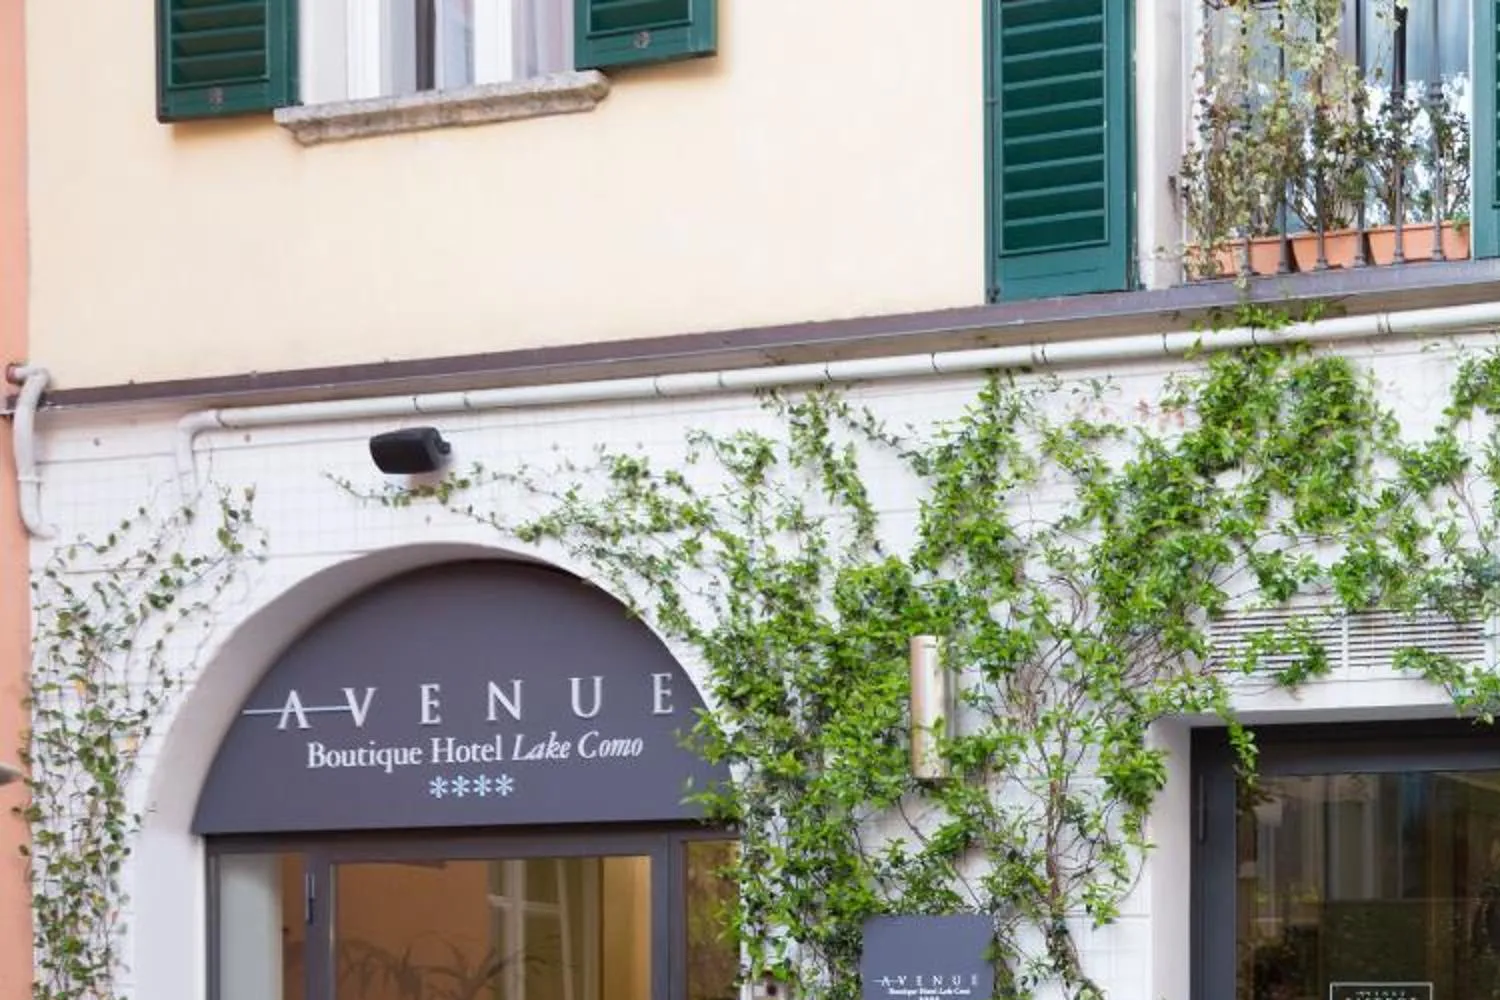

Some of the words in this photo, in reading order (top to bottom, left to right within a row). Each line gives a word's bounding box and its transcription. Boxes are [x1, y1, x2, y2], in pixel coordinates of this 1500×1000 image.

[275, 672, 674, 730] AVENUE
[306, 740, 423, 774] Boutique
[430, 736, 504, 764] Hotel
[511, 731, 571, 762] Lake
[576, 730, 645, 759] Como
